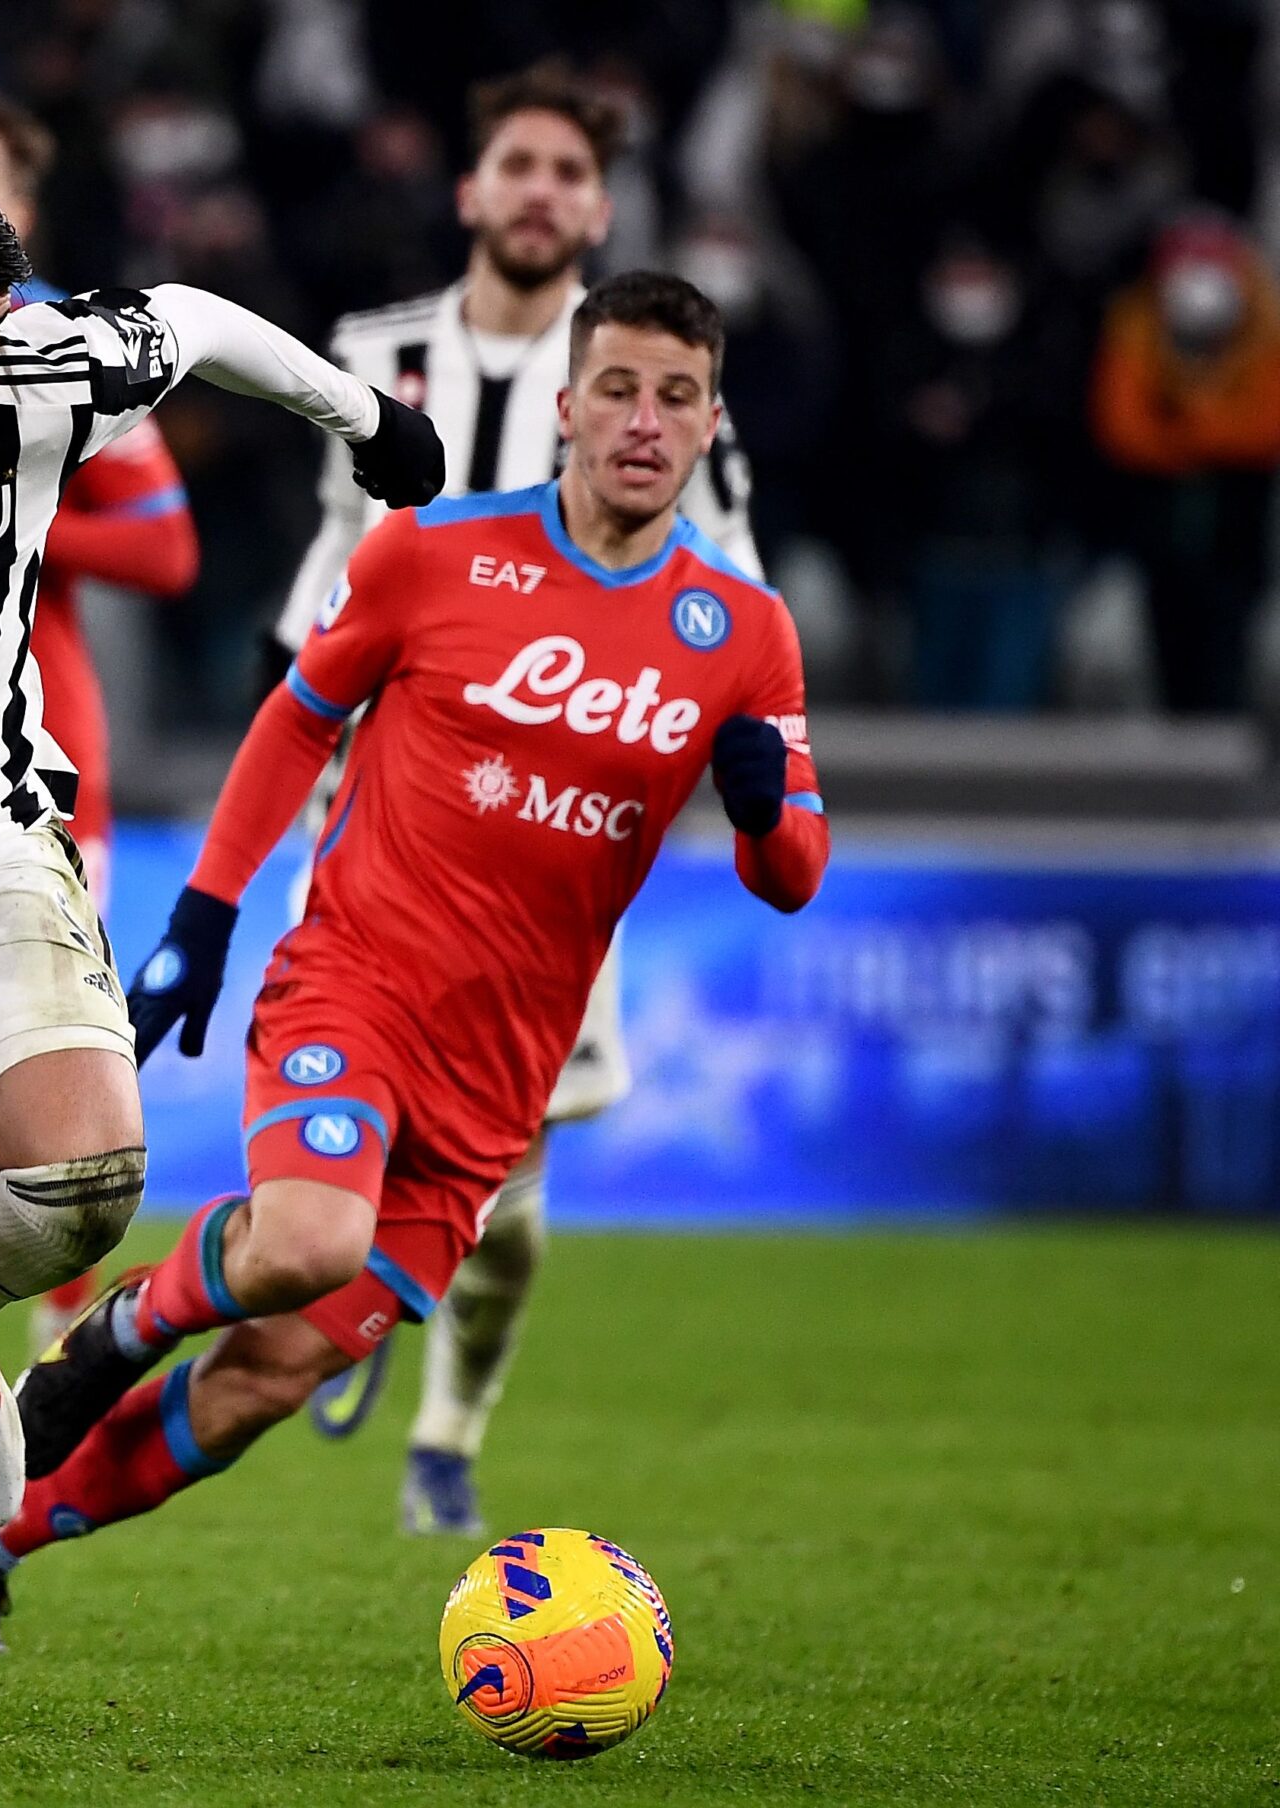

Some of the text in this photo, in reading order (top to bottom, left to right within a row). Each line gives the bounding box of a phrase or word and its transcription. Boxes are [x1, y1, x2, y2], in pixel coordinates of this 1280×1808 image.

[468, 554, 548, 595] EA7
[687, 601, 716, 636] N
[463, 635, 702, 755] Lete
[517, 774, 645, 842] MSC
[298, 1051, 329, 1077] N
[319, 1119, 347, 1146] N
[598, 1664, 627, 1684] ACC
